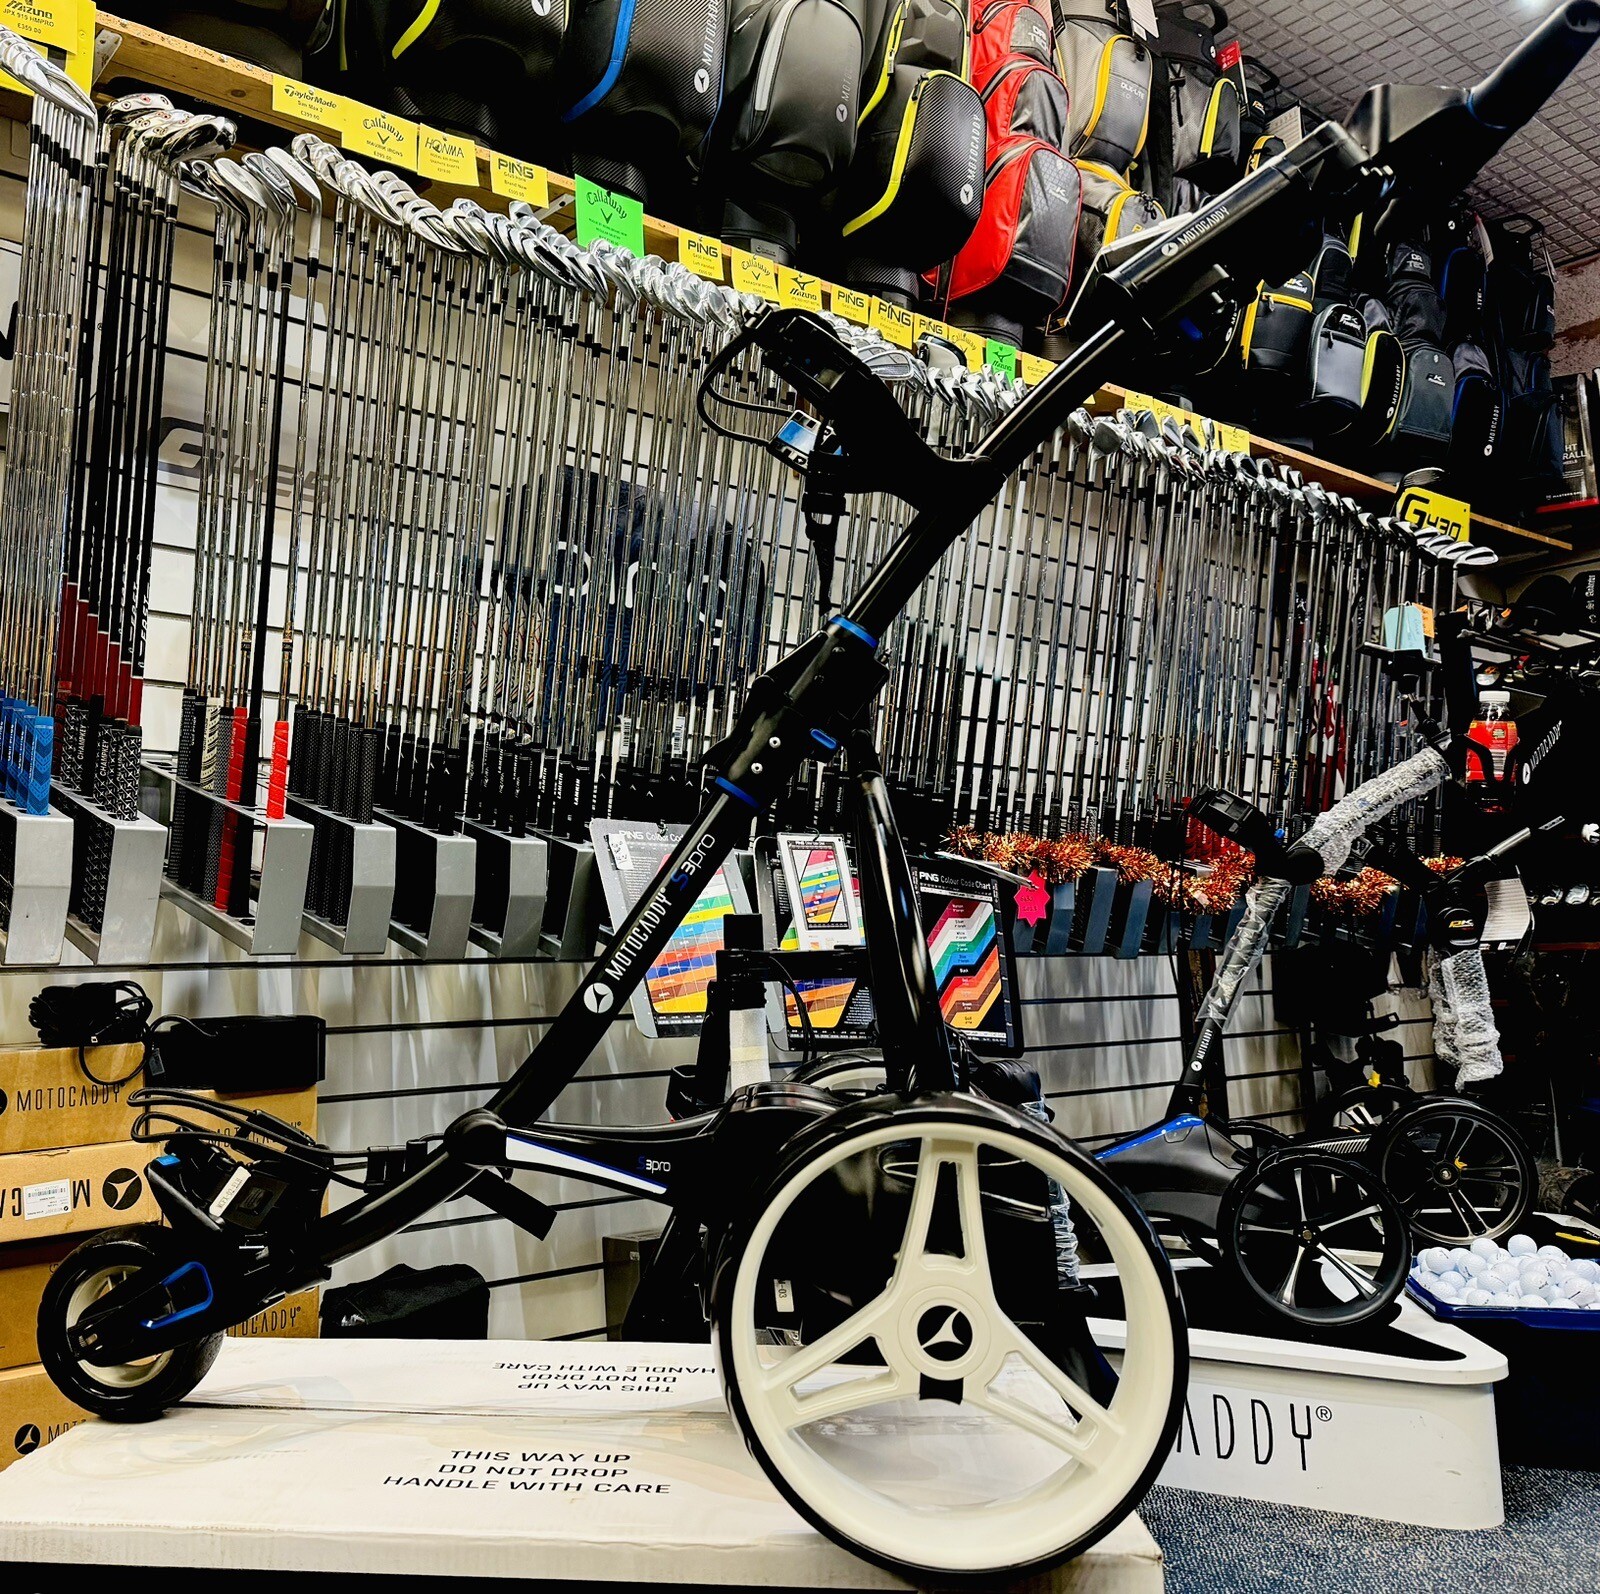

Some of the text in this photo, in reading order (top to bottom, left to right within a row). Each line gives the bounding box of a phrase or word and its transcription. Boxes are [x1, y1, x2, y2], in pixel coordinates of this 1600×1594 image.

[701, 0, 720, 66] MOTOCAD
[284, 85, 337, 109] TaylorMade
[363, 117, 405, 142] Callaway
[425, 137, 464, 158] HONMA
[966, 113, 982, 182] MOTOCADDY
[498, 158, 534, 180] PING
[586, 190, 627, 220] Callaway
[1177, 205, 1230, 247] MOTOCADDY
[687, 240, 719, 258] PING
[741, 259, 771, 277] Callaway
[837, 290, 864, 308] PING
[878, 302, 911, 326] PING
[919, 318, 943, 335] PING
[1391, 365, 1401, 405] MOTOCADDY
[1488, 404, 1500, 443] MOTOCADDY
[1562, 450, 1587, 461] RALL
[1565, 443, 1578, 452] HT
[1400, 493, 1462, 542] G430
[77, 724, 88, 760] CHAMPKEY
[1529, 720, 1562, 772] MOTOCADDY
[99, 739, 110, 777] CHAMPKEY
[618, 829, 684, 842] PING Colour Cod
[919, 871, 991, 890] PING Colour Code Chart
[1196, 1028, 1213, 1060] MOTOCADDY
[492, 1362, 717, 1374] HANDLE WITH CARE
[522, 1373, 678, 1384] DO NOT DROP
[517, 1383, 674, 1393] THIS WAY UP
[1177, 1392, 1333, 1472] ADDY®
[450, 1450, 632, 1464] THIS WAY UP
[438, 1464, 629, 1478] DO NOT DROP
[383, 1476, 672, 1495] HANDLE WITH CARE
